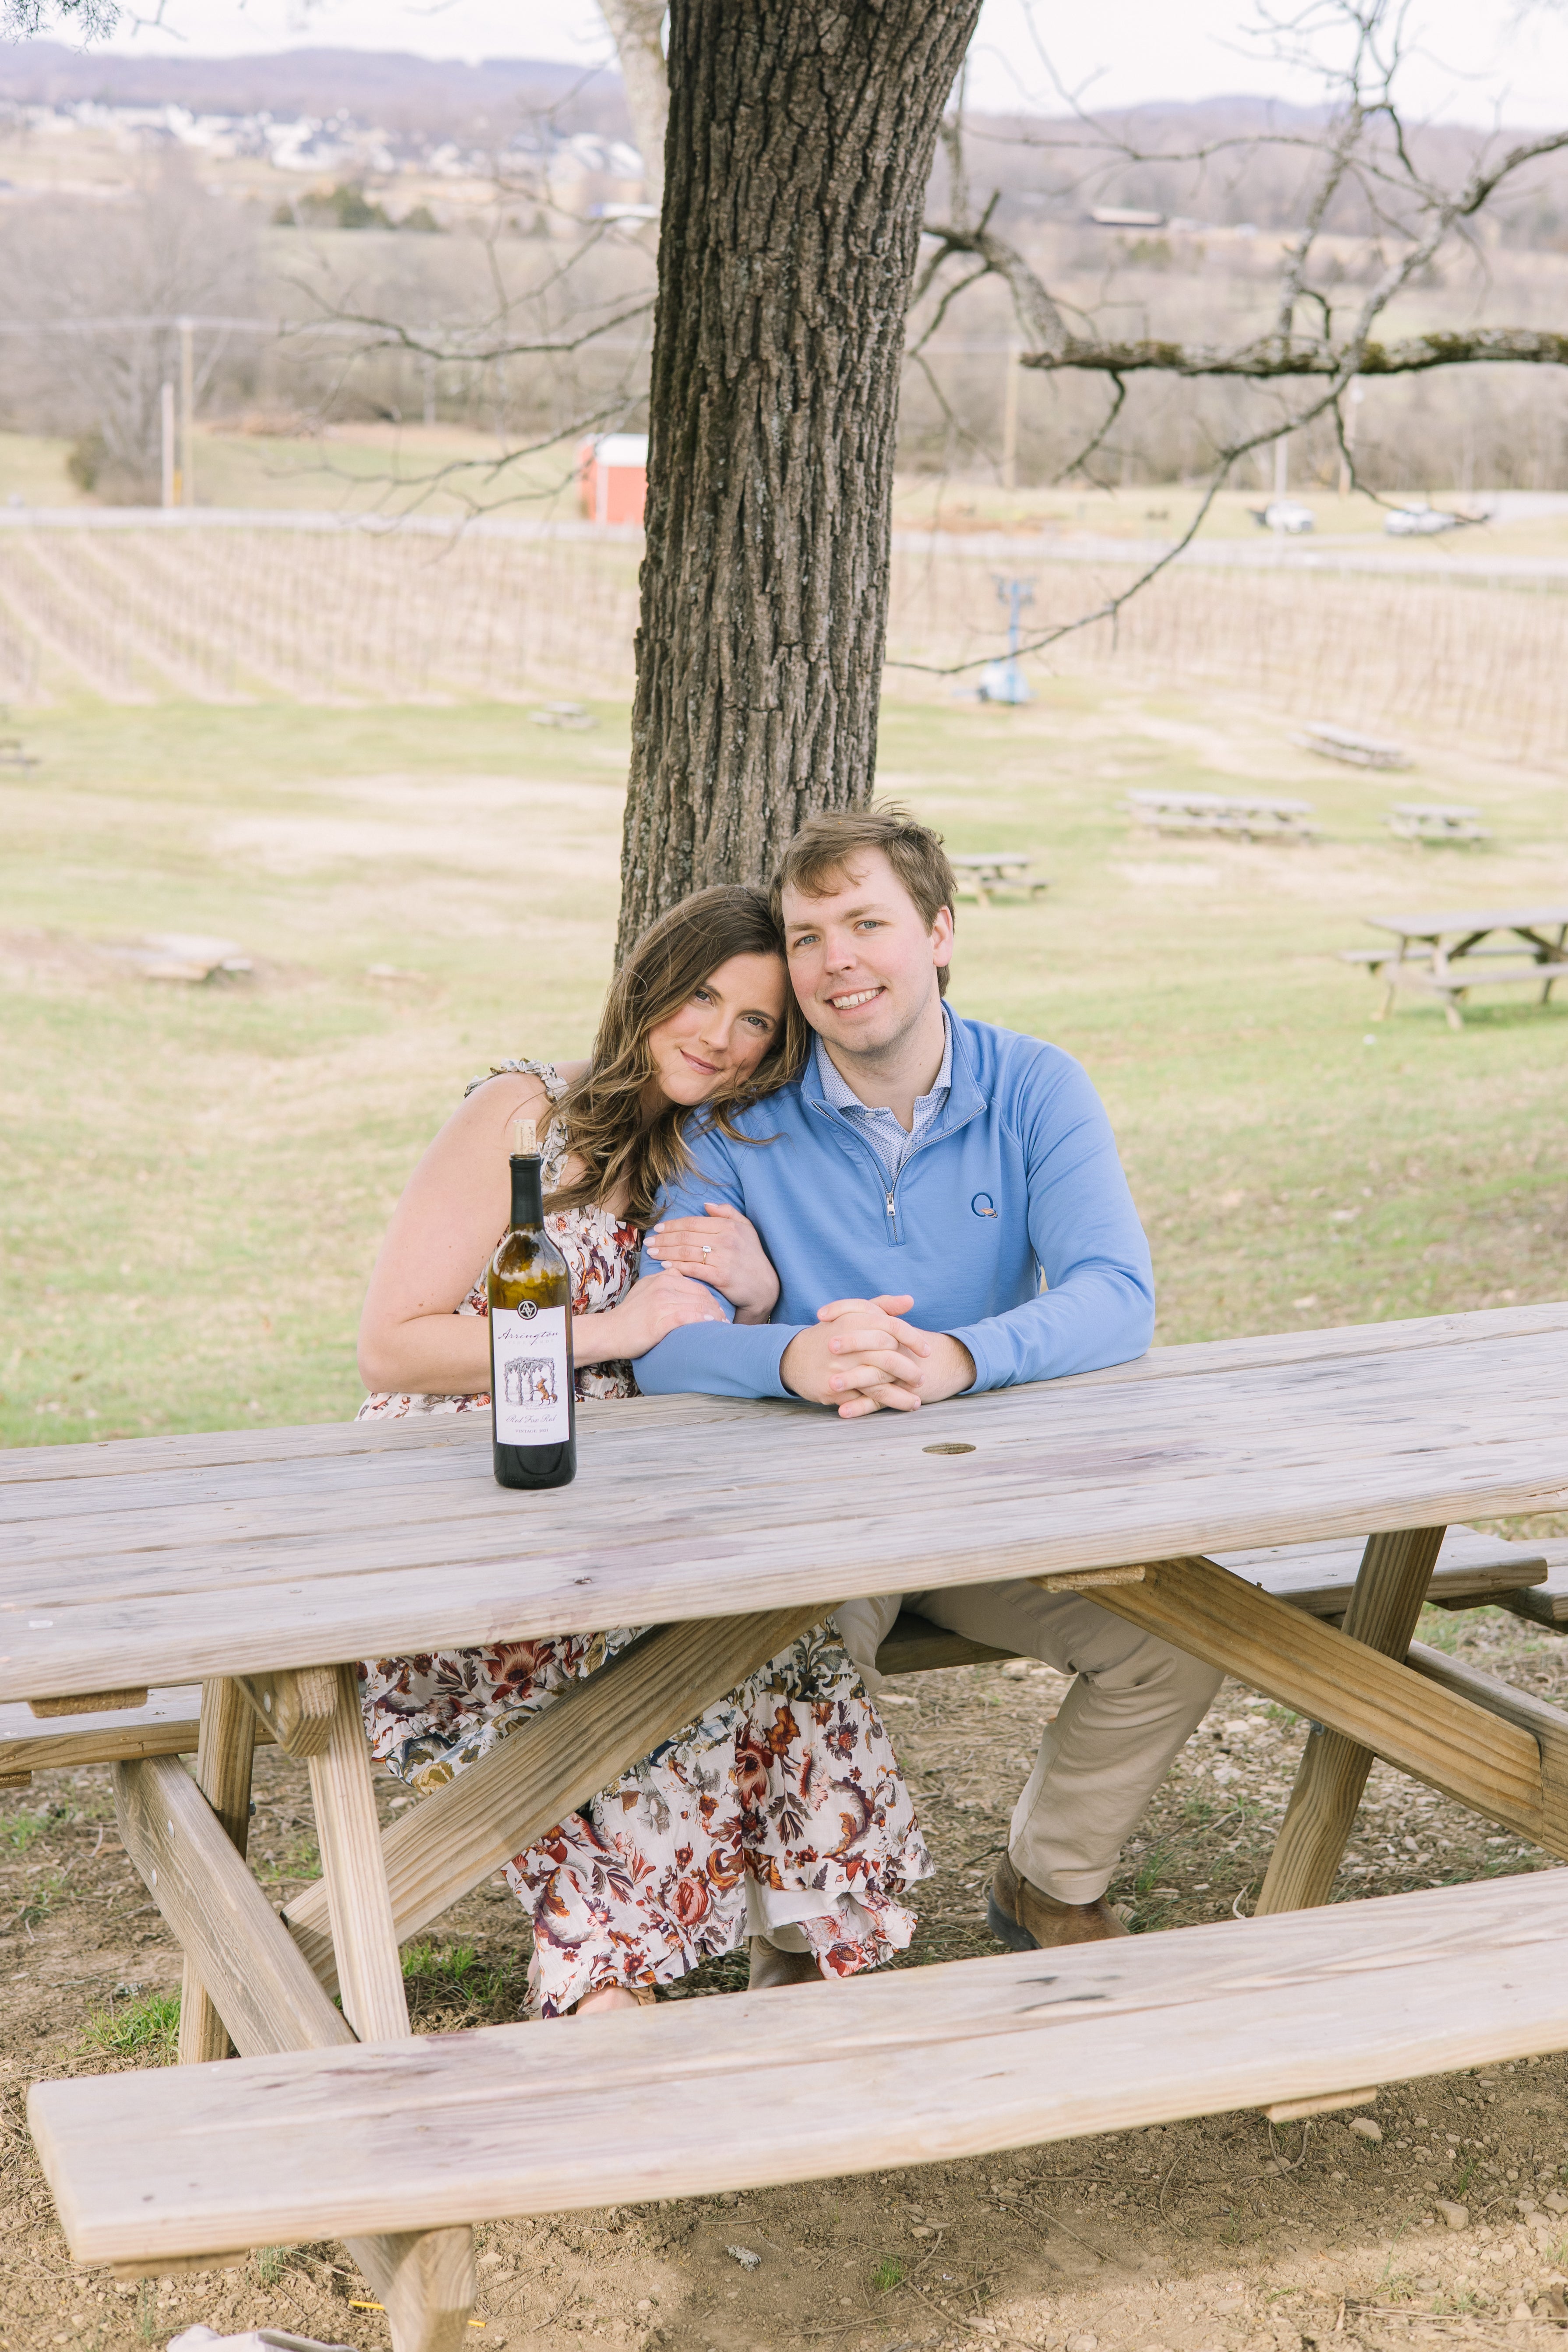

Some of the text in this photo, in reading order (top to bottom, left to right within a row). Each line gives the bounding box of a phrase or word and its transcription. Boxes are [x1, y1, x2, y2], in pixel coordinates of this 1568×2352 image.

[498, 1328, 559, 1346] Arrington
[506, 1414, 557, 1423] Red Fox Red
